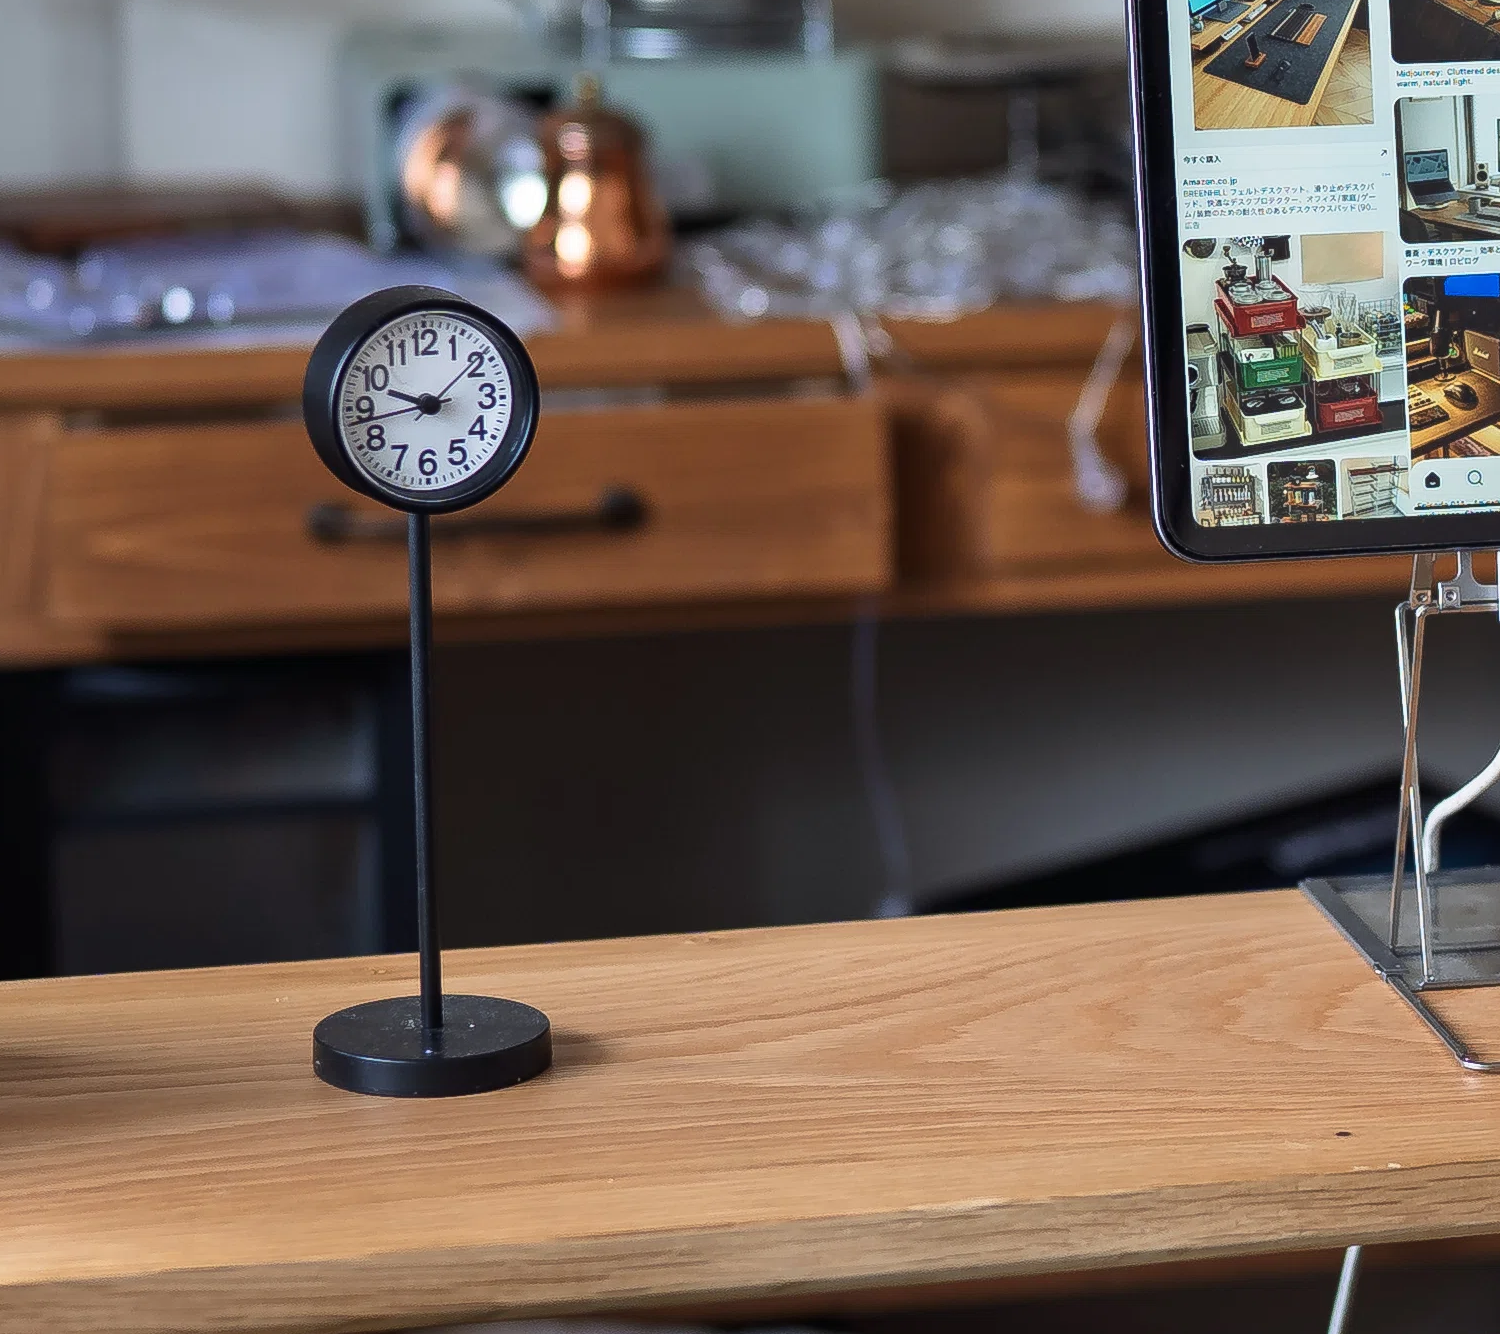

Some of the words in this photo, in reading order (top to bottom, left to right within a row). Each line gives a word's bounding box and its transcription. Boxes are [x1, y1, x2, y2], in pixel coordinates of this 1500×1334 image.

[1396, 69, 1443, 78] Midjourney:
[1446, 67, 1485, 76] Cluttered
[1422, 79, 1451, 87] natural
[1452, 78, 1473, 87] light.
[1182, 155, 1222, 164] 今すぐ購入
[1182, 177, 1238, 187] Amazon.co.jp
[386, 339, 407, 366] 11
[411, 328, 439, 356] 12
[448, 334, 457, 361] 1
[363, 364, 390, 392] 10
[467, 351, 486, 378] 2
[356, 395, 375, 422] 9
[478, 383, 497, 410] 3
[366, 424, 386, 451] 8
[468, 414, 488, 441] 4
[390, 444, 409, 471] 7
[418, 448, 438, 476] 6
[448, 438, 467, 466] 5
